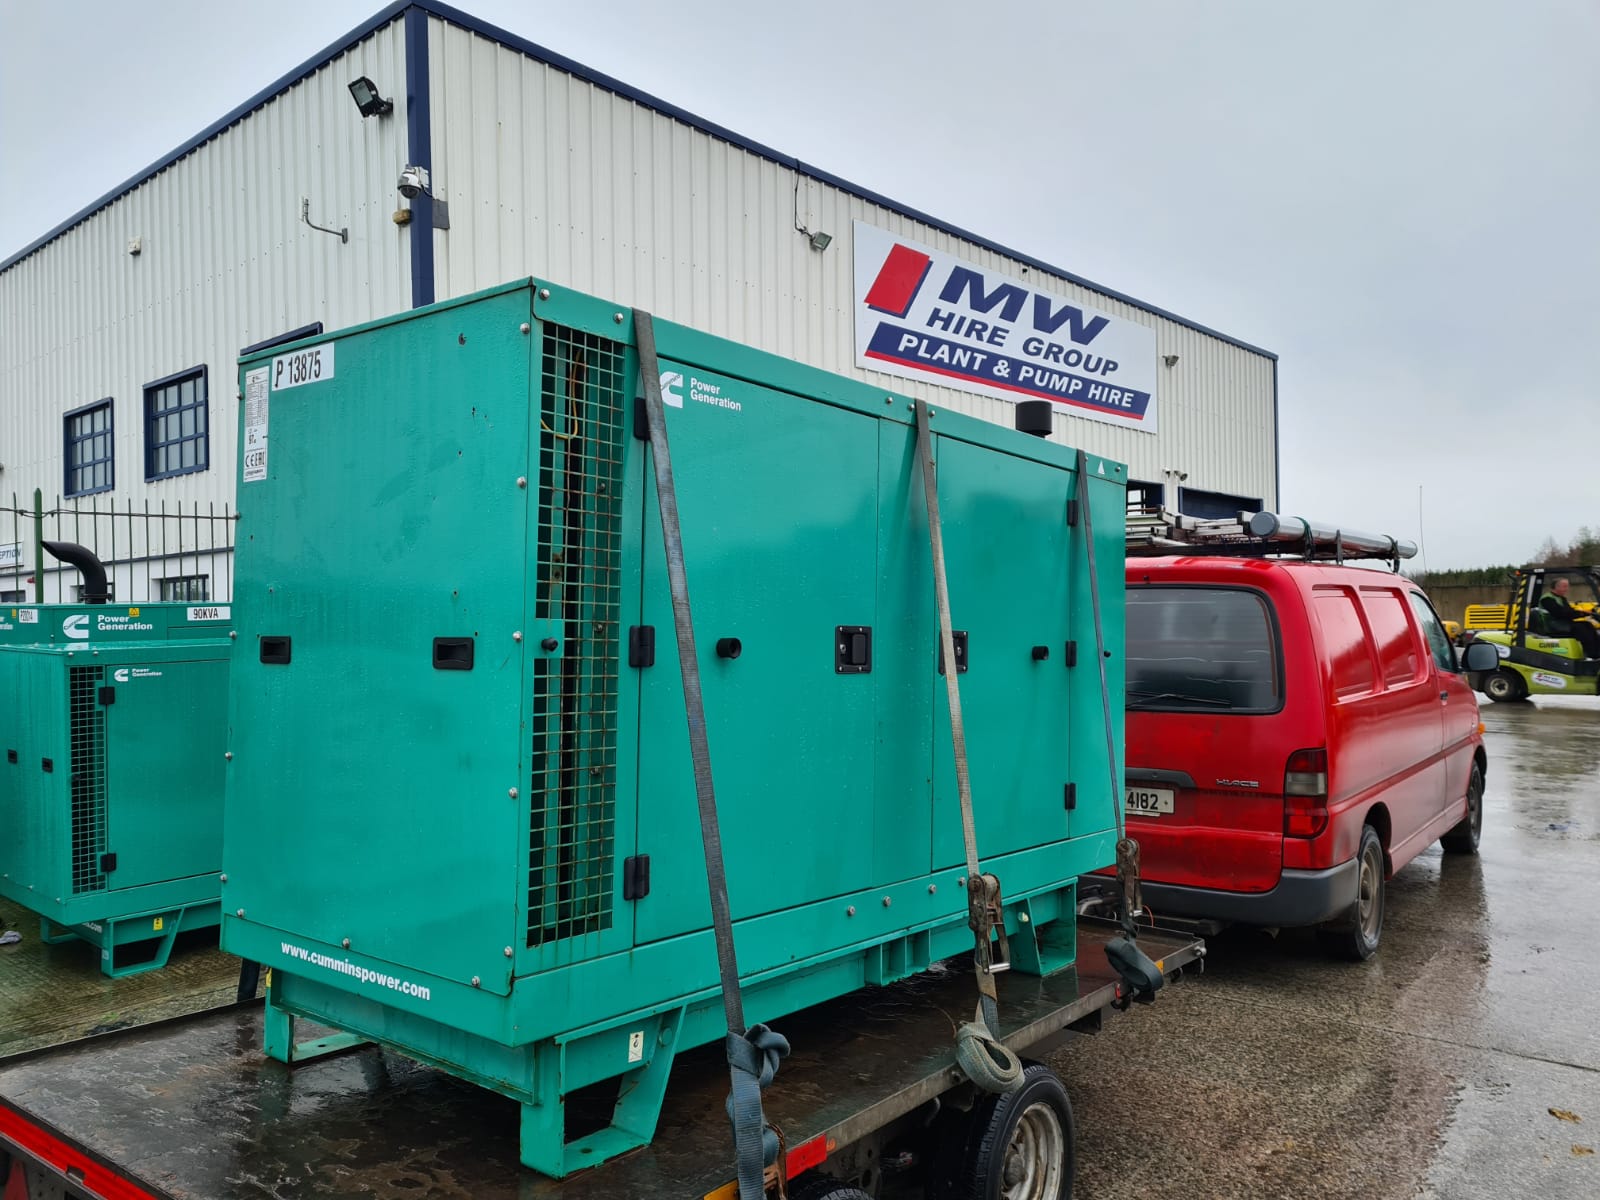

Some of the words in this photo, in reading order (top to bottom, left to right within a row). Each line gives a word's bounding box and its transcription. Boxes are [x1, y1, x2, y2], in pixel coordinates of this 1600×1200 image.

[938, 265, 1110, 345] MW
[926, 307, 1010, 347] HIRE
[1022, 337, 1119, 377] GROUP
[275, 360, 284, 388] P
[288, 350, 321, 384] 13875
[898, 333, 987, 371] PLANT
[993, 358, 1010, 378] &
[1018, 365, 1083, 394] PUMP
[1087, 384, 1135, 409] HIRE
[690, 377, 721, 395] Power
[690, 389, 742, 411] Generation
[97, 614, 130, 623] Power
[193, 608, 219, 619] 90KVA
[97, 622, 153, 631] Generation
[1127, 791, 1159, 810] 4182
[281, 942, 431, 1001] www.cumminspower.com
